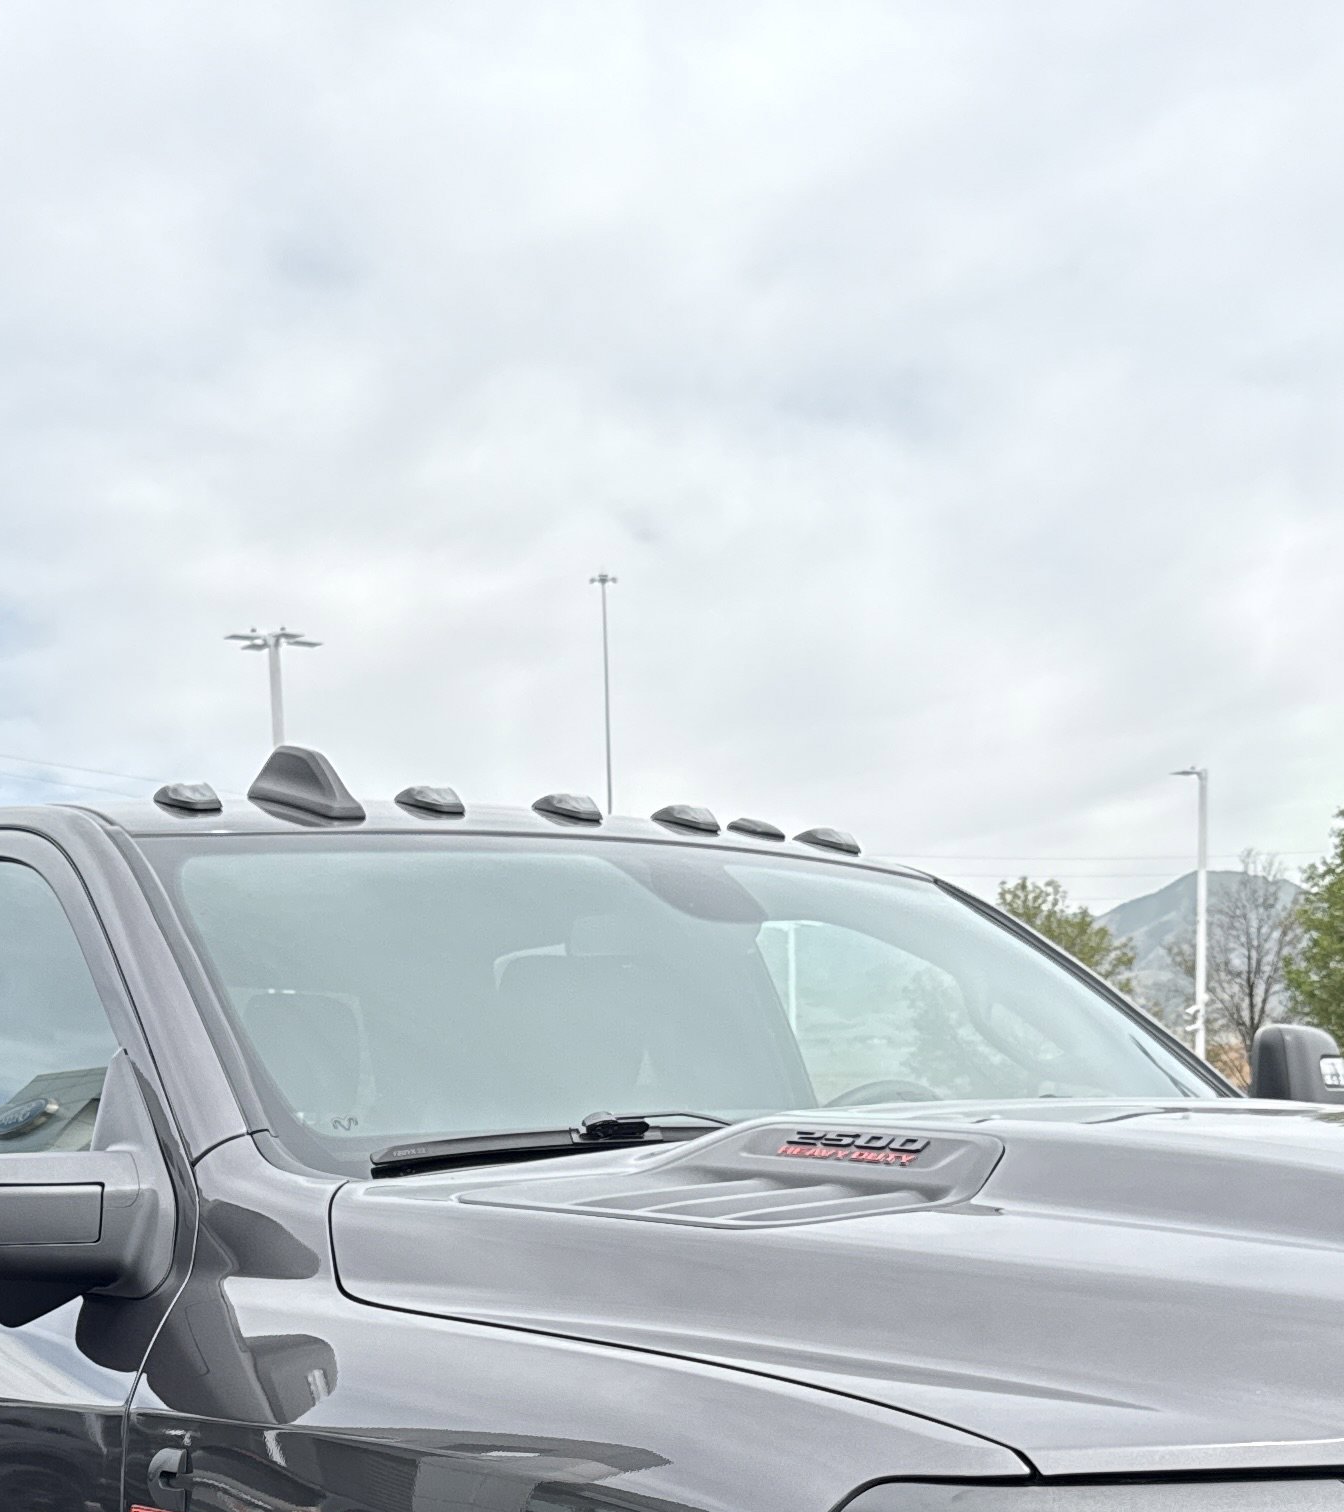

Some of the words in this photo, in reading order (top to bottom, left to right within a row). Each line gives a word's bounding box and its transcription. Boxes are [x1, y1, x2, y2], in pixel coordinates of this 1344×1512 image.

[786, 1131, 930, 1153] 2500
[777, 1145, 850, 1160] HEAVY
[848, 1151, 919, 1167] DUTY
